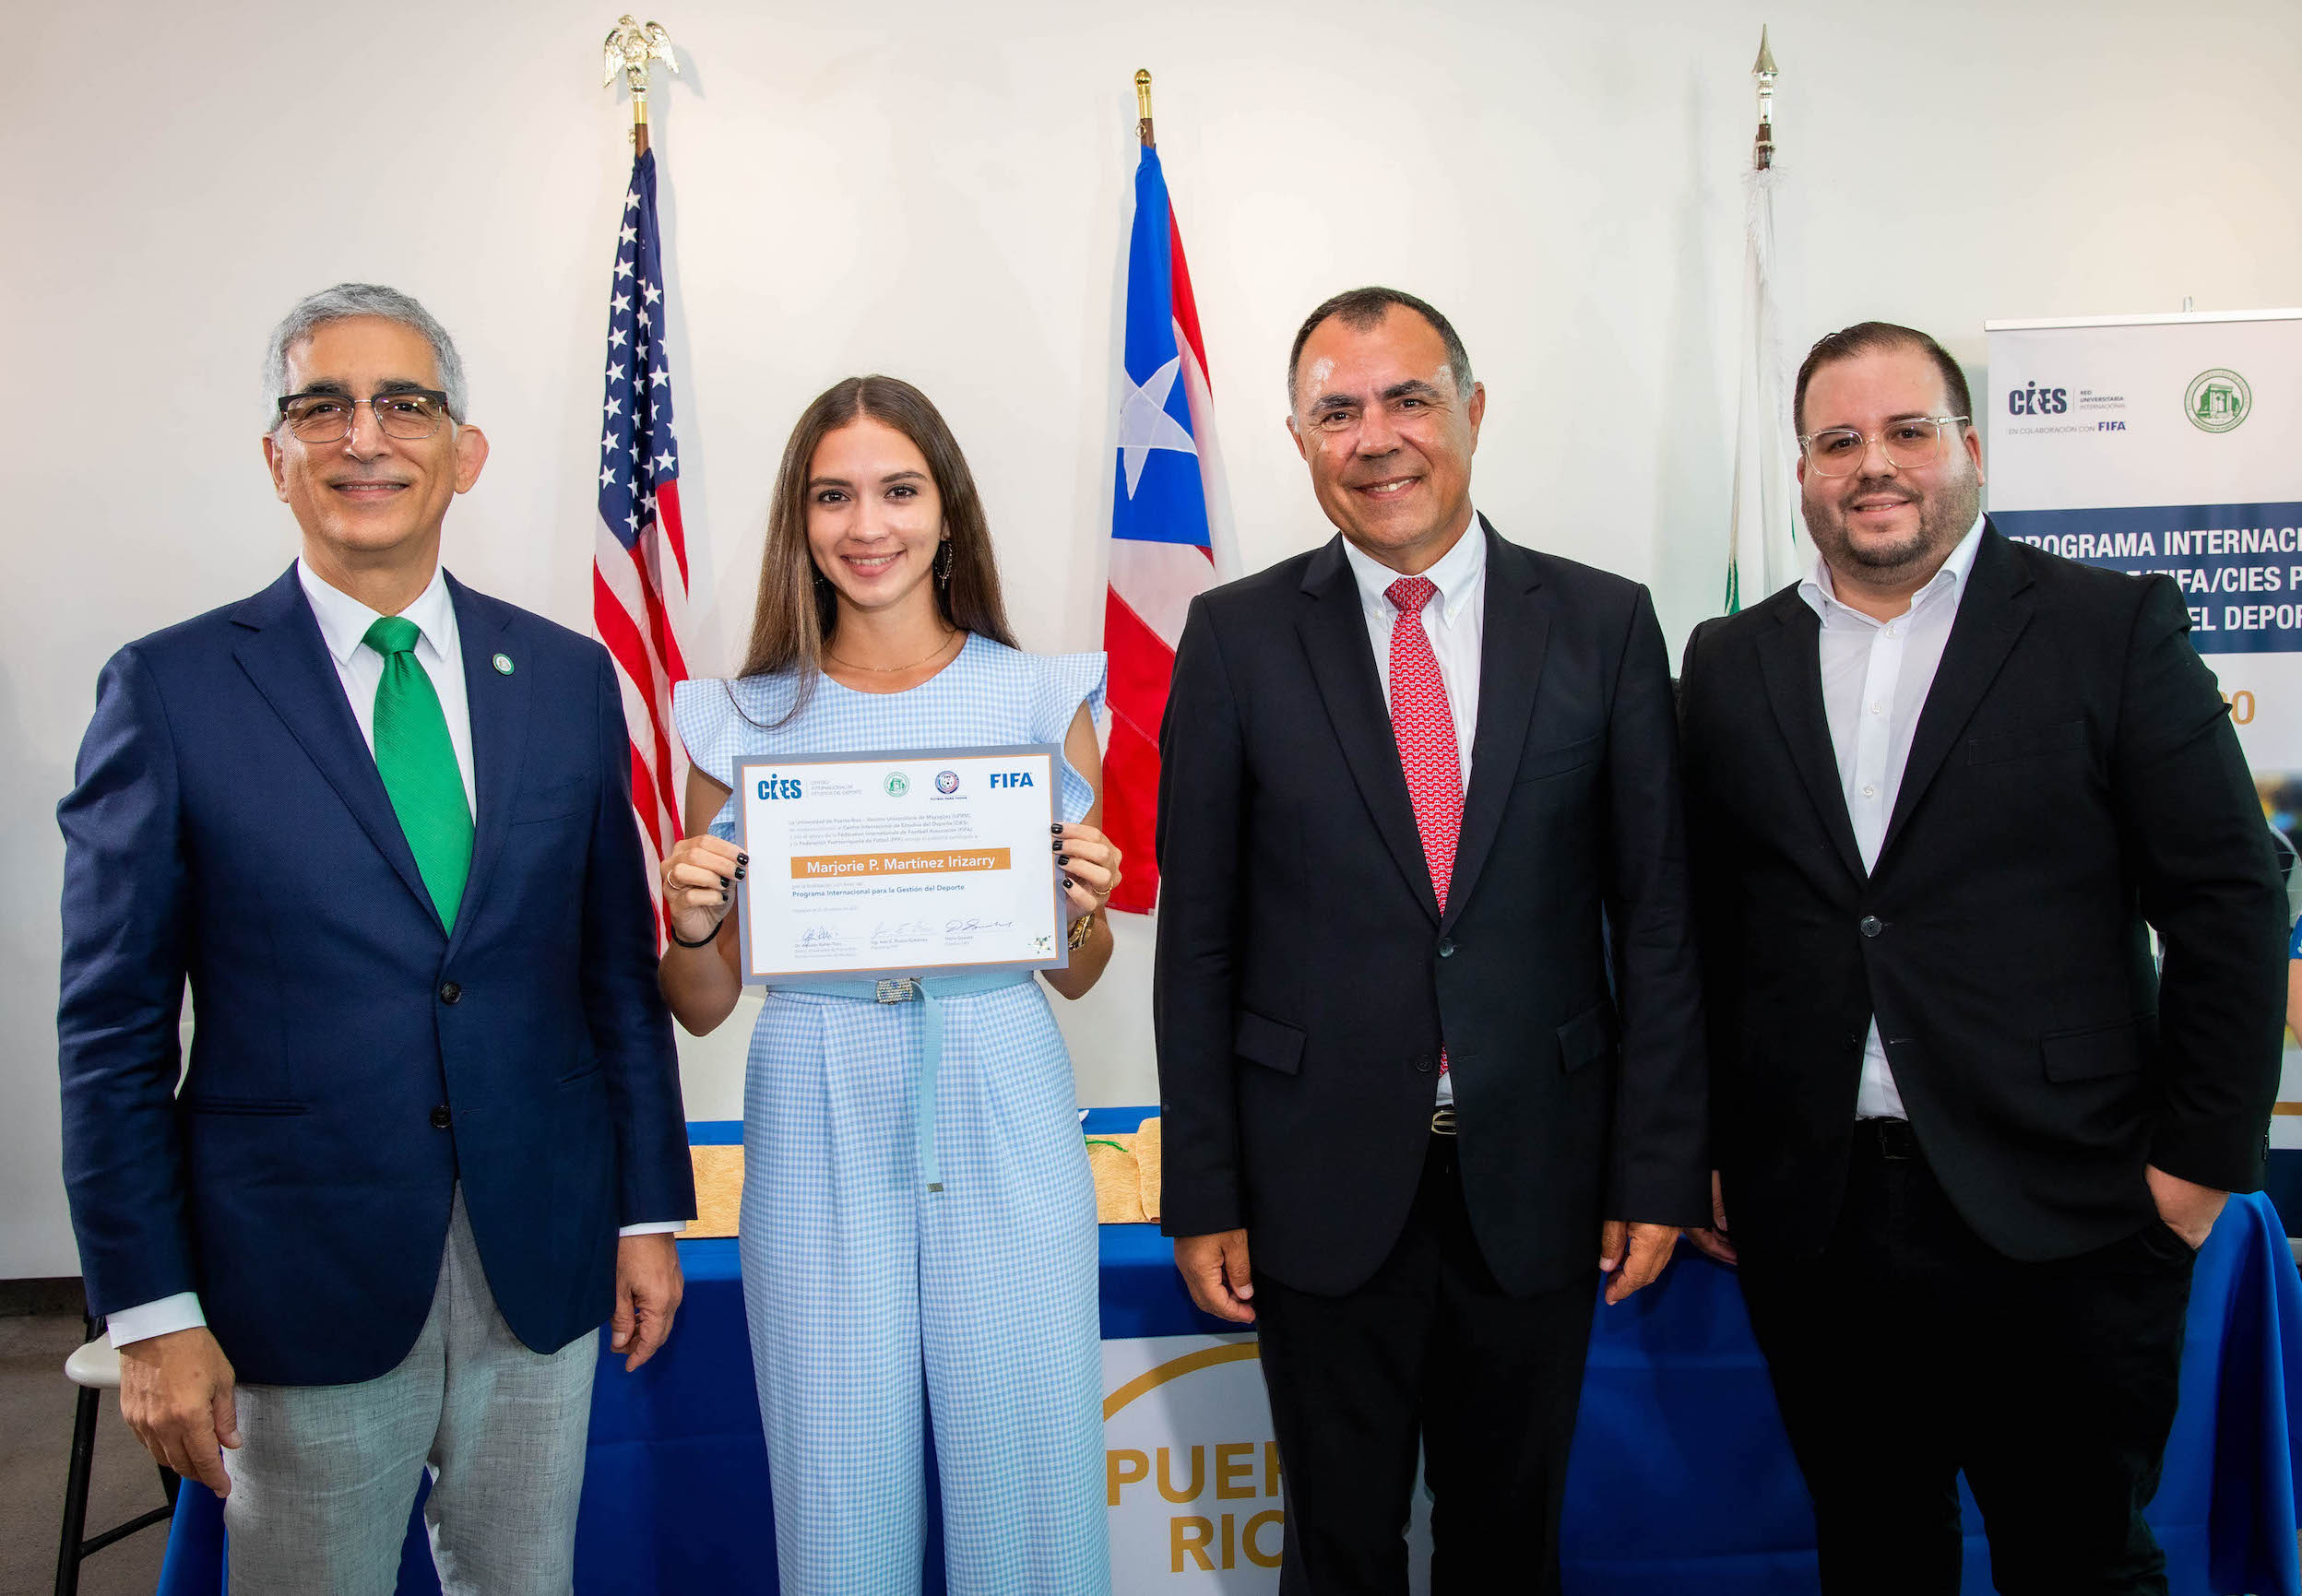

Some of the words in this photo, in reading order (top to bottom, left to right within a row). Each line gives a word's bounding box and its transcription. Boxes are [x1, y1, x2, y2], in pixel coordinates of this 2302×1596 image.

[2009, 381, 2067, 415] CIES
[2097, 421, 2126, 432] FIFA
[758, 774, 801, 800] CIES
[991, 772, 1034, 788] FIFA
[807, 860, 864, 875] Marjorie
[869, 858, 879, 870] P.
[884, 857, 944, 870] Martínez
[948, 856, 995, 869] Irizarry
[792, 891, 825, 899] Programa
[826, 888, 871, 896] Internacional
[896, 885, 922, 893] Gestión
[936, 884, 965, 893] Deporte
